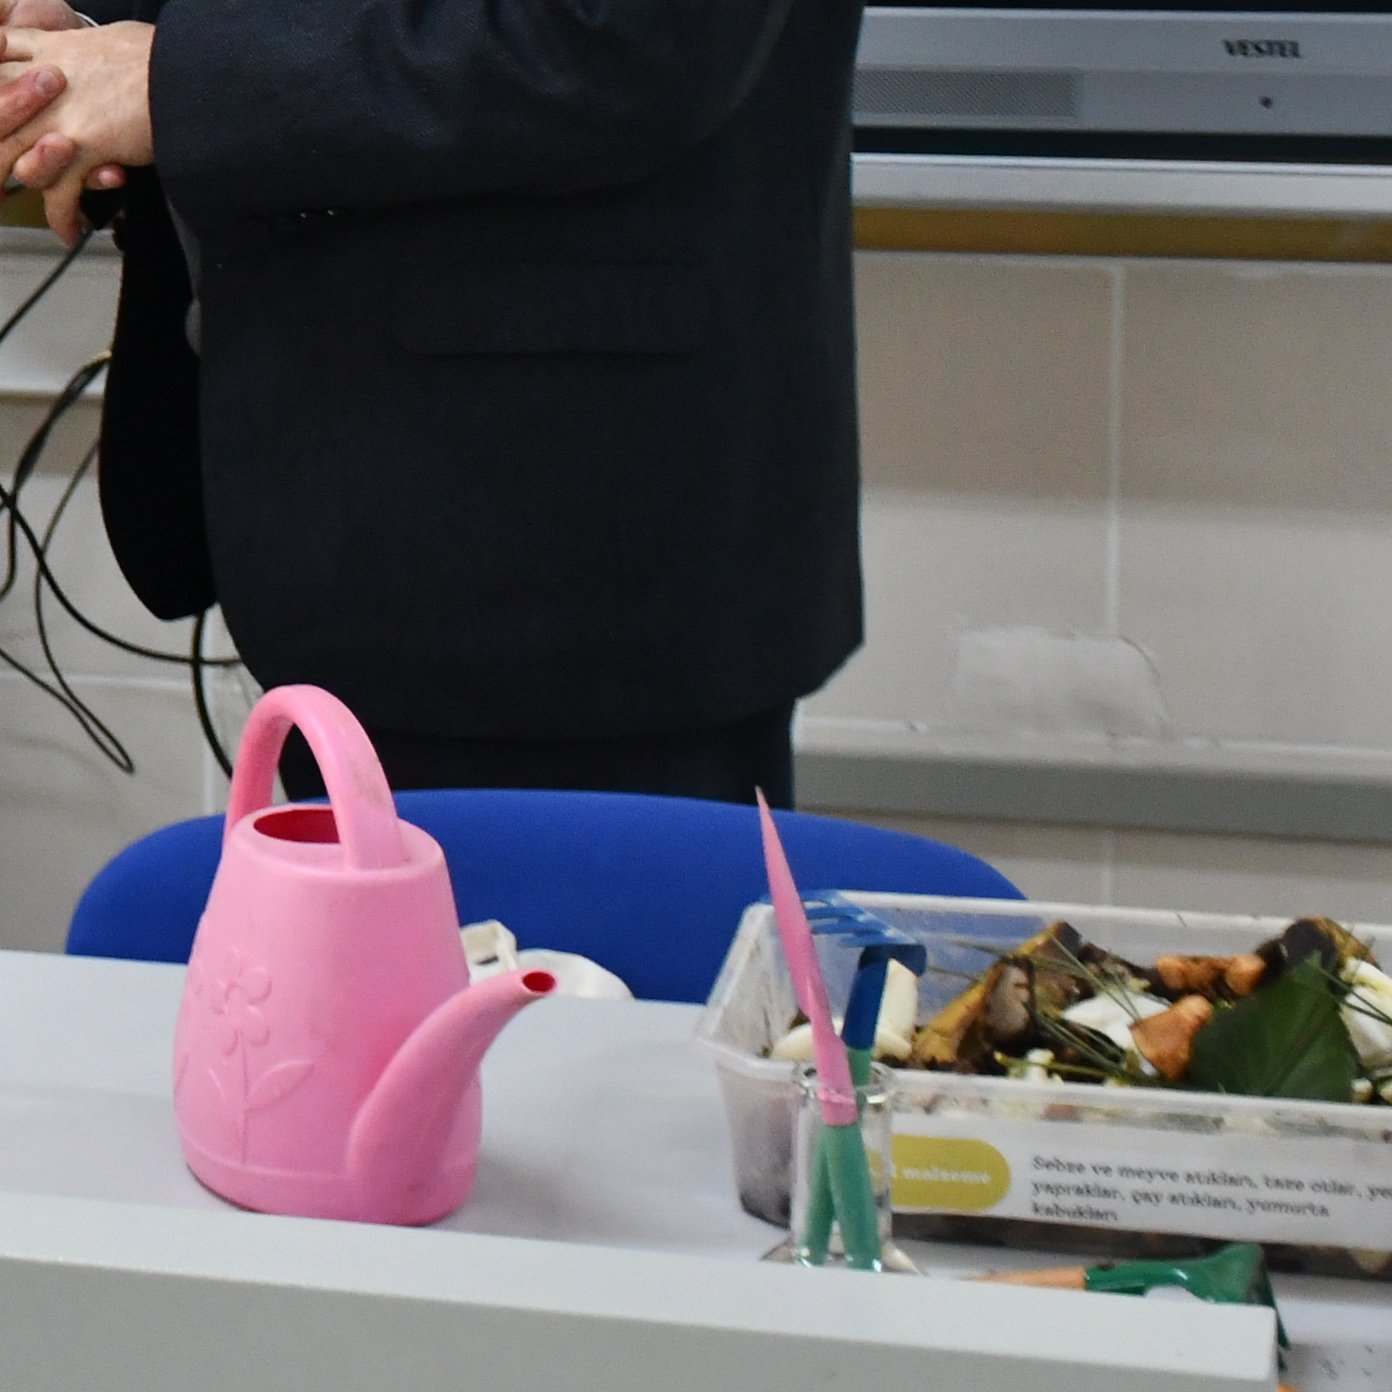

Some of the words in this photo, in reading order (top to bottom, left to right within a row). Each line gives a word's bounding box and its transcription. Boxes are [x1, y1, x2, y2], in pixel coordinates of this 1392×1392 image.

[1031, 1154, 1086, 1174] Sebze
[1089, 1163, 1113, 1177] ve
[1117, 1164, 1180, 1184] meyve
[1131, 1189, 1163, 1207] çay
[1245, 1196, 1331, 1218] yumurta
